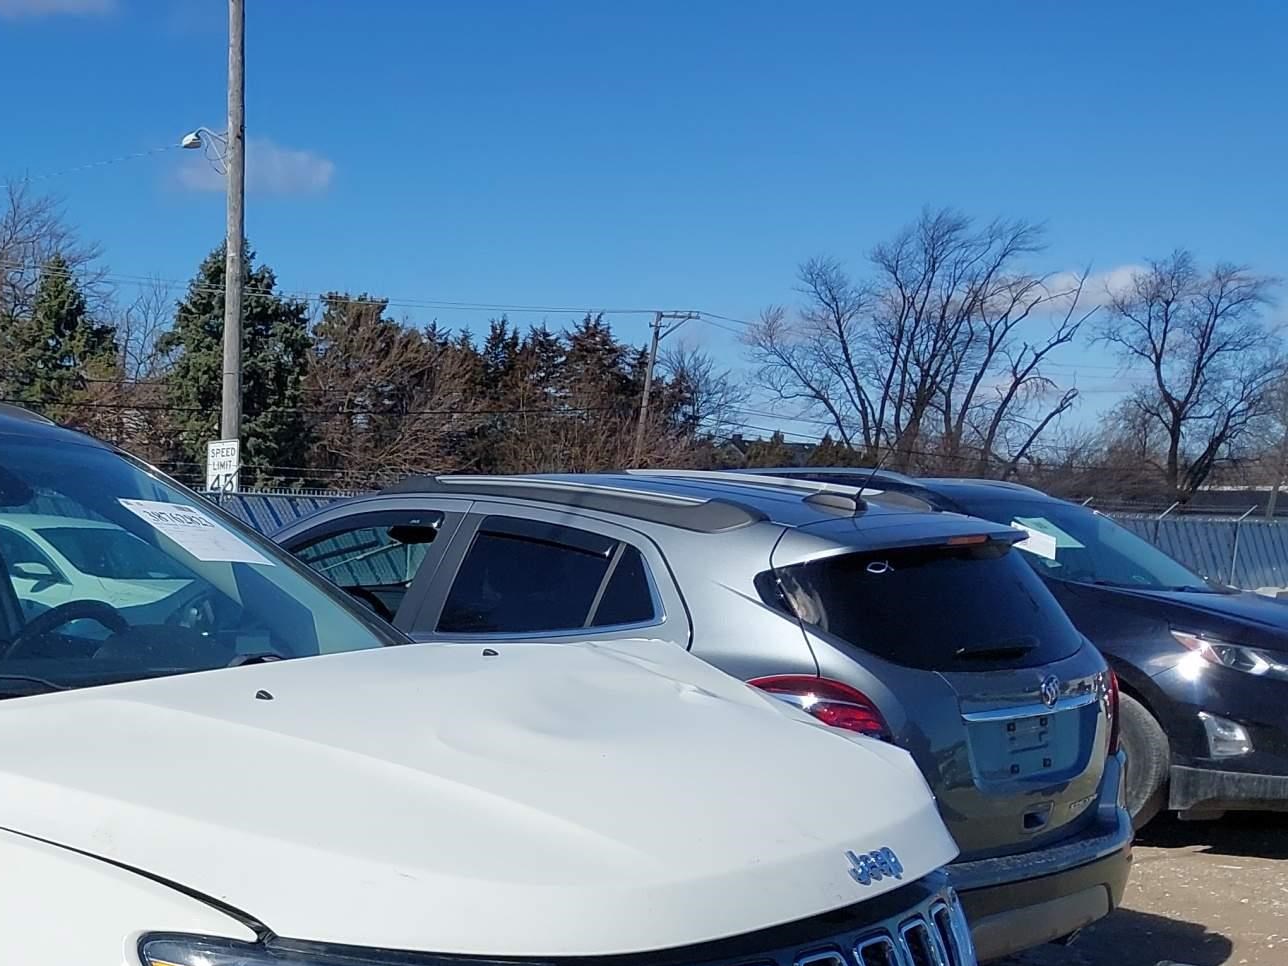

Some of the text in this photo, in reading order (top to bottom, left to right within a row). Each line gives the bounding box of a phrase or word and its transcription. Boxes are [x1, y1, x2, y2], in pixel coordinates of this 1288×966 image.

[210, 447, 236, 458] SPEED
[212, 460, 233, 471] LIMIT
[210, 473, 234, 490] 45
[844, 846, 904, 886] Jeep
